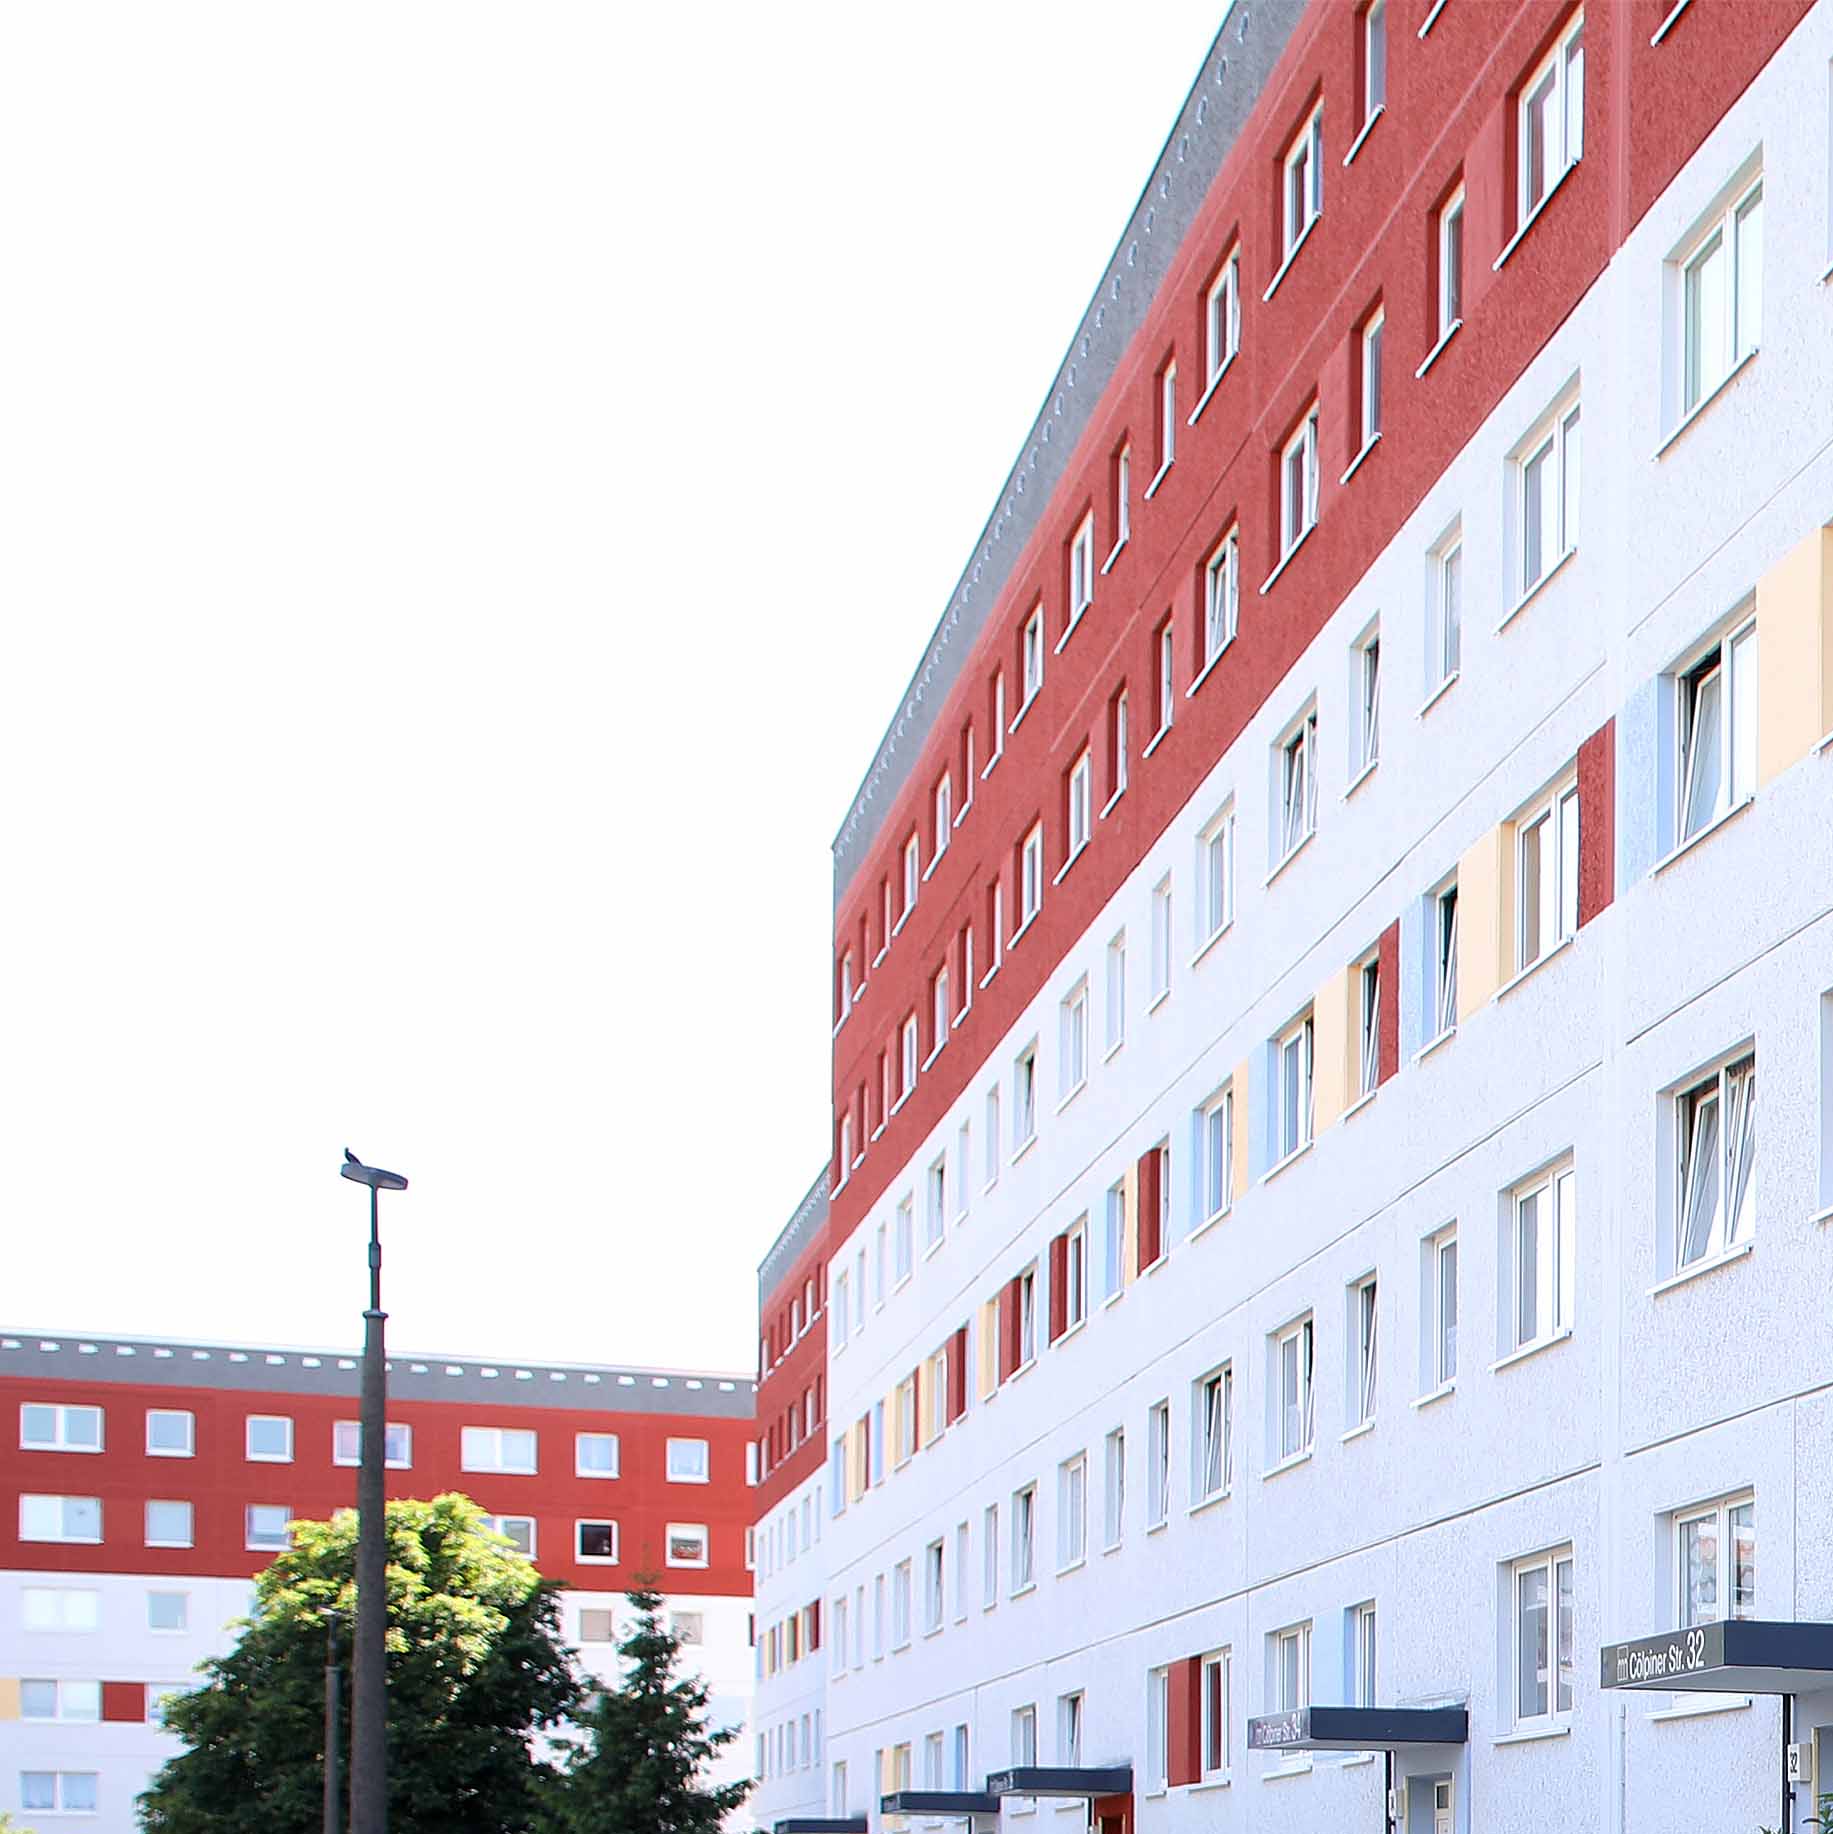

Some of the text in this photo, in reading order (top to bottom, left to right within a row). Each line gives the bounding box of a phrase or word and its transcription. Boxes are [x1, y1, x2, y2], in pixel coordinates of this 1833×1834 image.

[1630, 1630, 1705, 1680] Cölpiner Str. 32
[1790, 1752, 1798, 1773] 32
